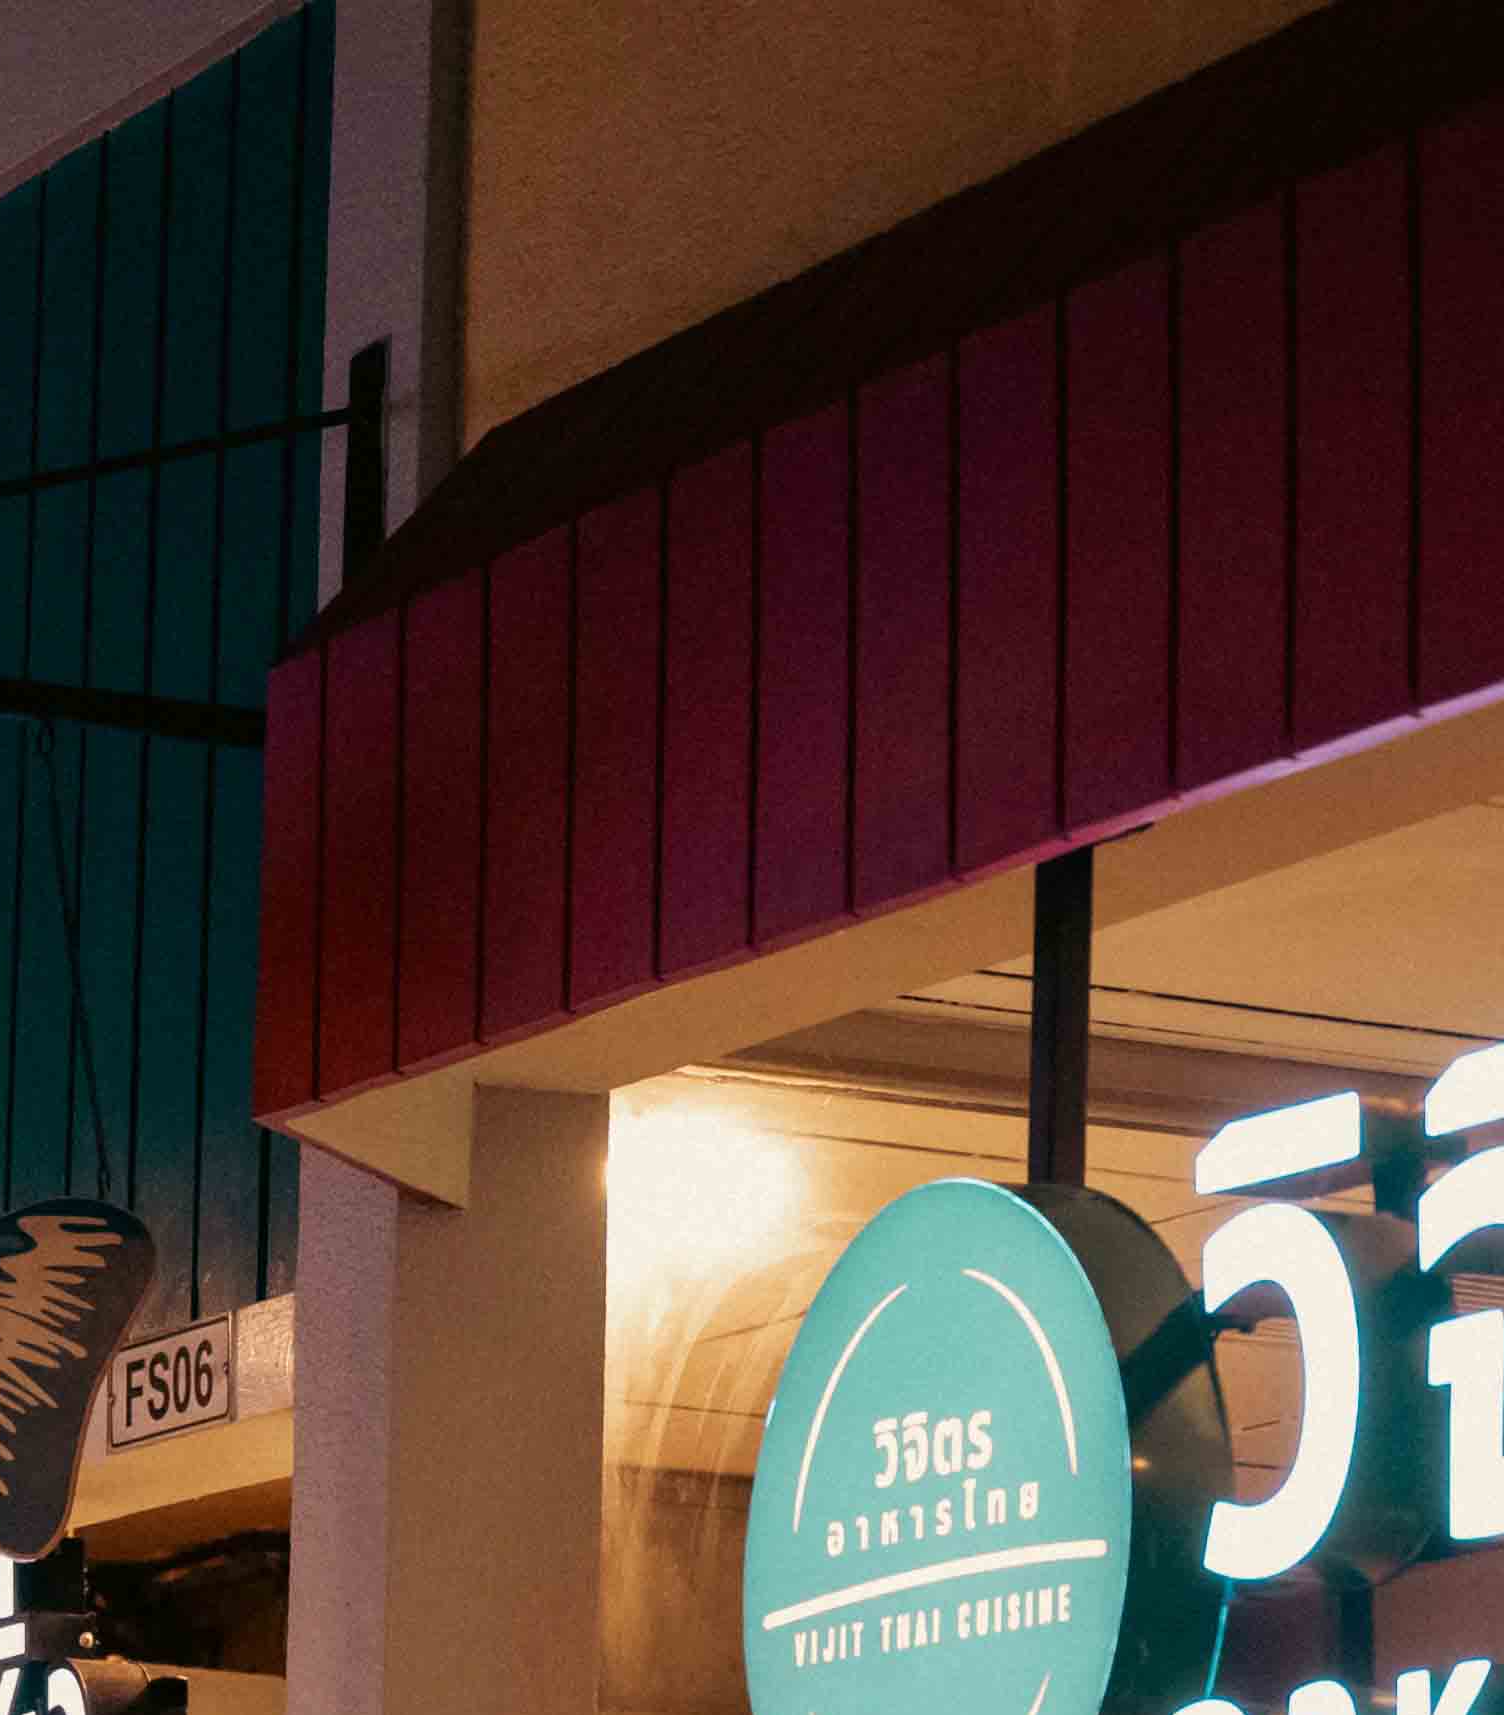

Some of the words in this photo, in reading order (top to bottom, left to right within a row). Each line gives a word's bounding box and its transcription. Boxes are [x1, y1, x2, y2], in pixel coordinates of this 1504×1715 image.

[126, 1340, 212, 1427] FS06
[873, 1410, 992, 1488] วิจิตร
[826, 1478, 1038, 1557] อาหารไทย
[794, 1621, 864, 1667] VIJIT
[881, 1608, 941, 1653] THAI
[957, 1584, 1071, 1638] CUISINE
